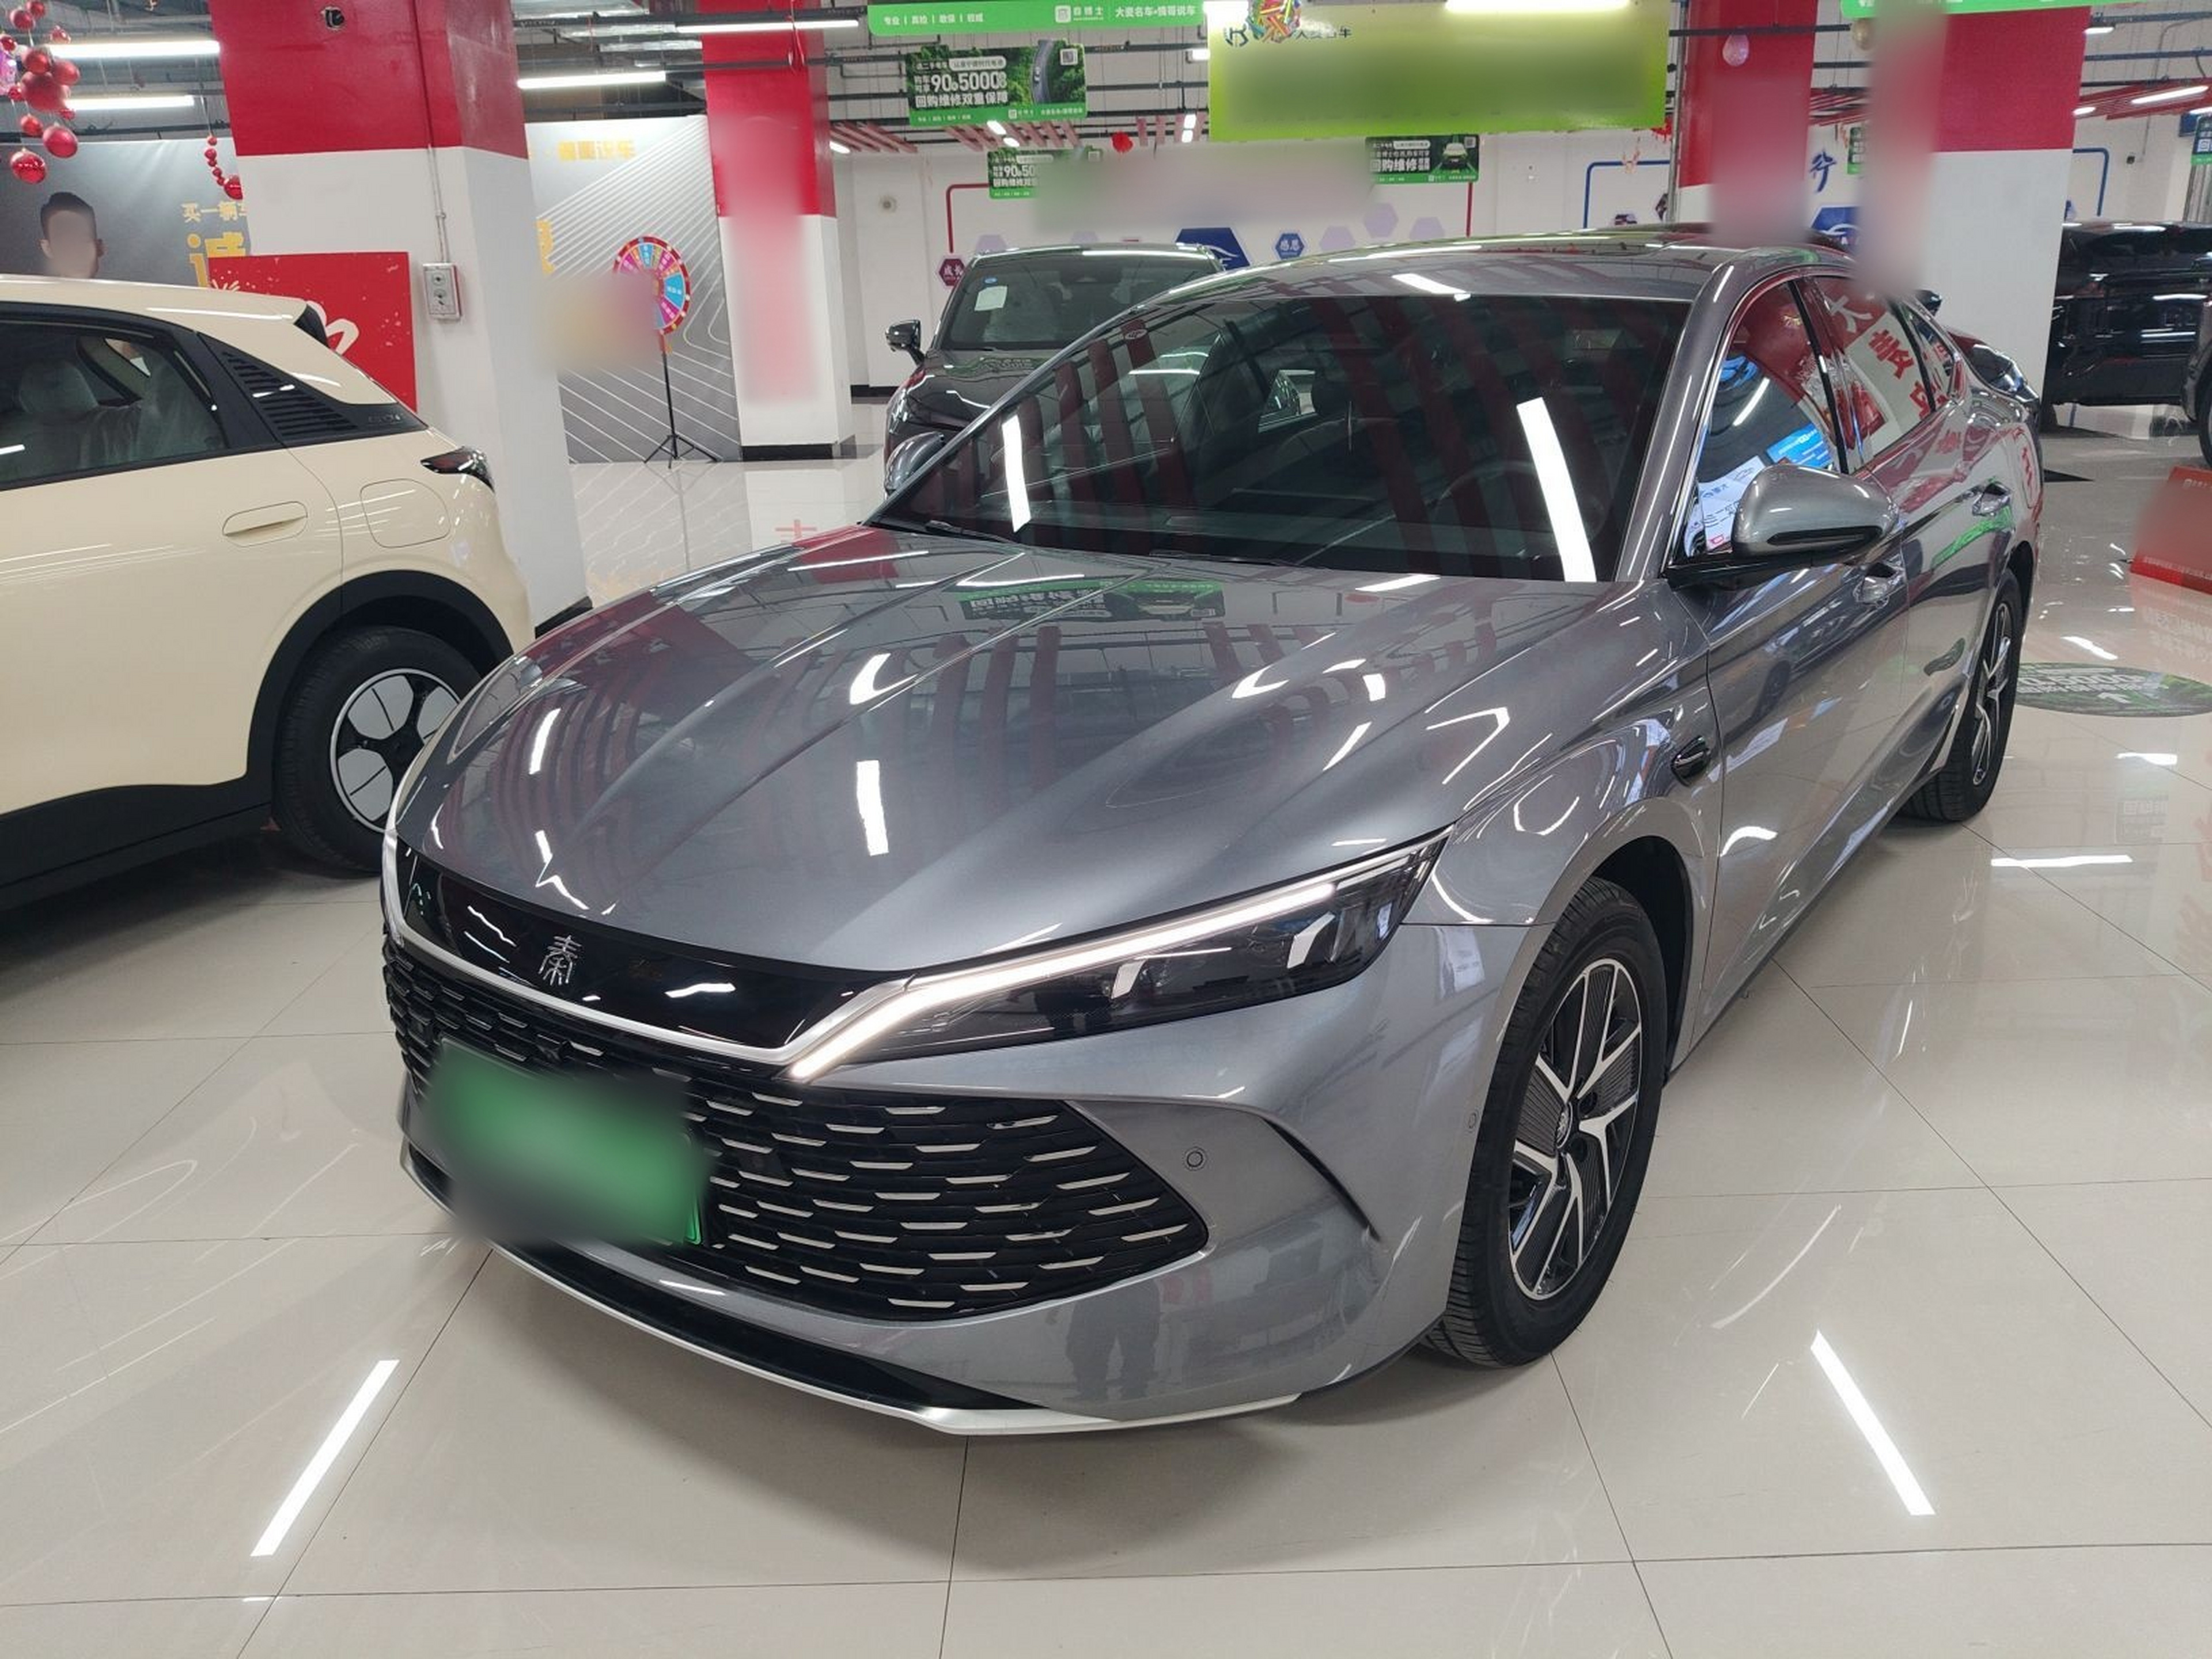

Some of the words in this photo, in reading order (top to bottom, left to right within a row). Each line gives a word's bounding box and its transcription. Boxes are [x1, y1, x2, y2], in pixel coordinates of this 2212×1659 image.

[915, 91, 1008, 108] 回购维修双重保障
